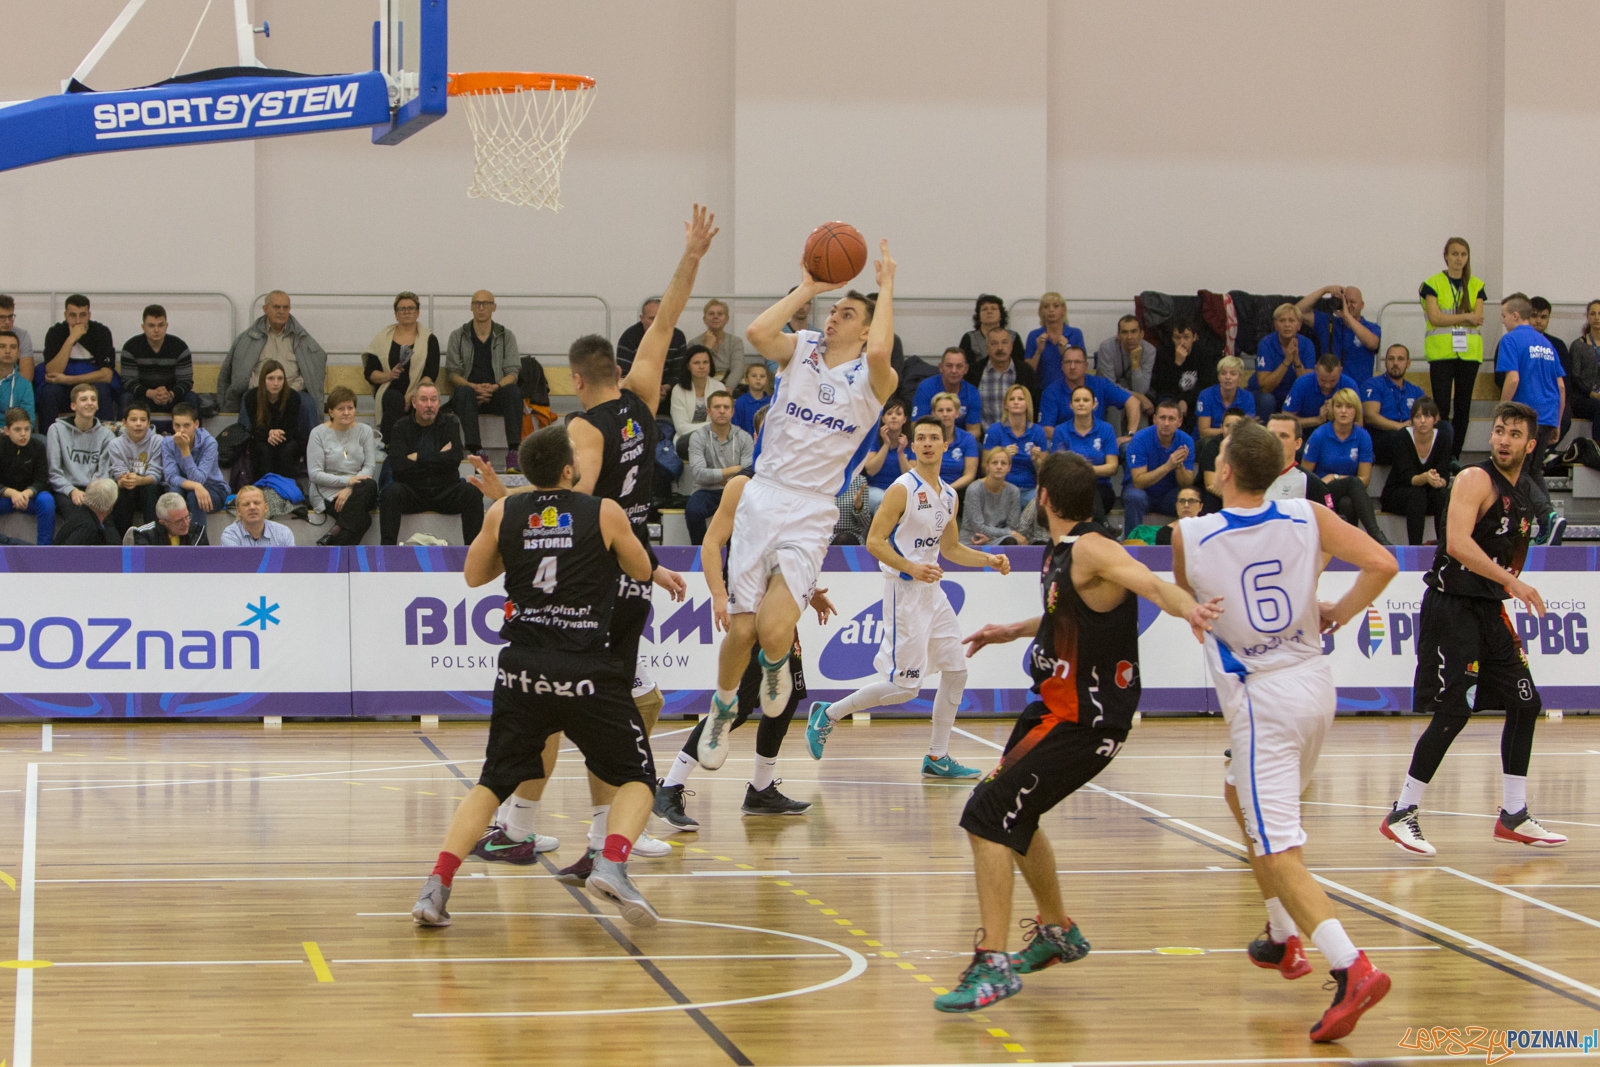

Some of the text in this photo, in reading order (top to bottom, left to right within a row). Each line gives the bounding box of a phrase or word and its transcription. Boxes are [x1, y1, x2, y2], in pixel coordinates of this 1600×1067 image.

[93, 82, 360, 129] SPORTSYSTEM
[818, 383, 835, 405] 8
[786, 402, 857, 434] BIOFARM
[67, 446, 100, 465] VANS
[935, 511, 945, 531] 2
[1495, 517, 1510, 535] 3
[523, 537, 573, 550] ASTORIA
[532, 556, 558, 594] 4
[1241, 559, 1292, 633] 6
[1515, 612, 1589, 655] PBG
[431, 656, 494, 668] POLSKI
[1518, 678, 1533, 700] 3
